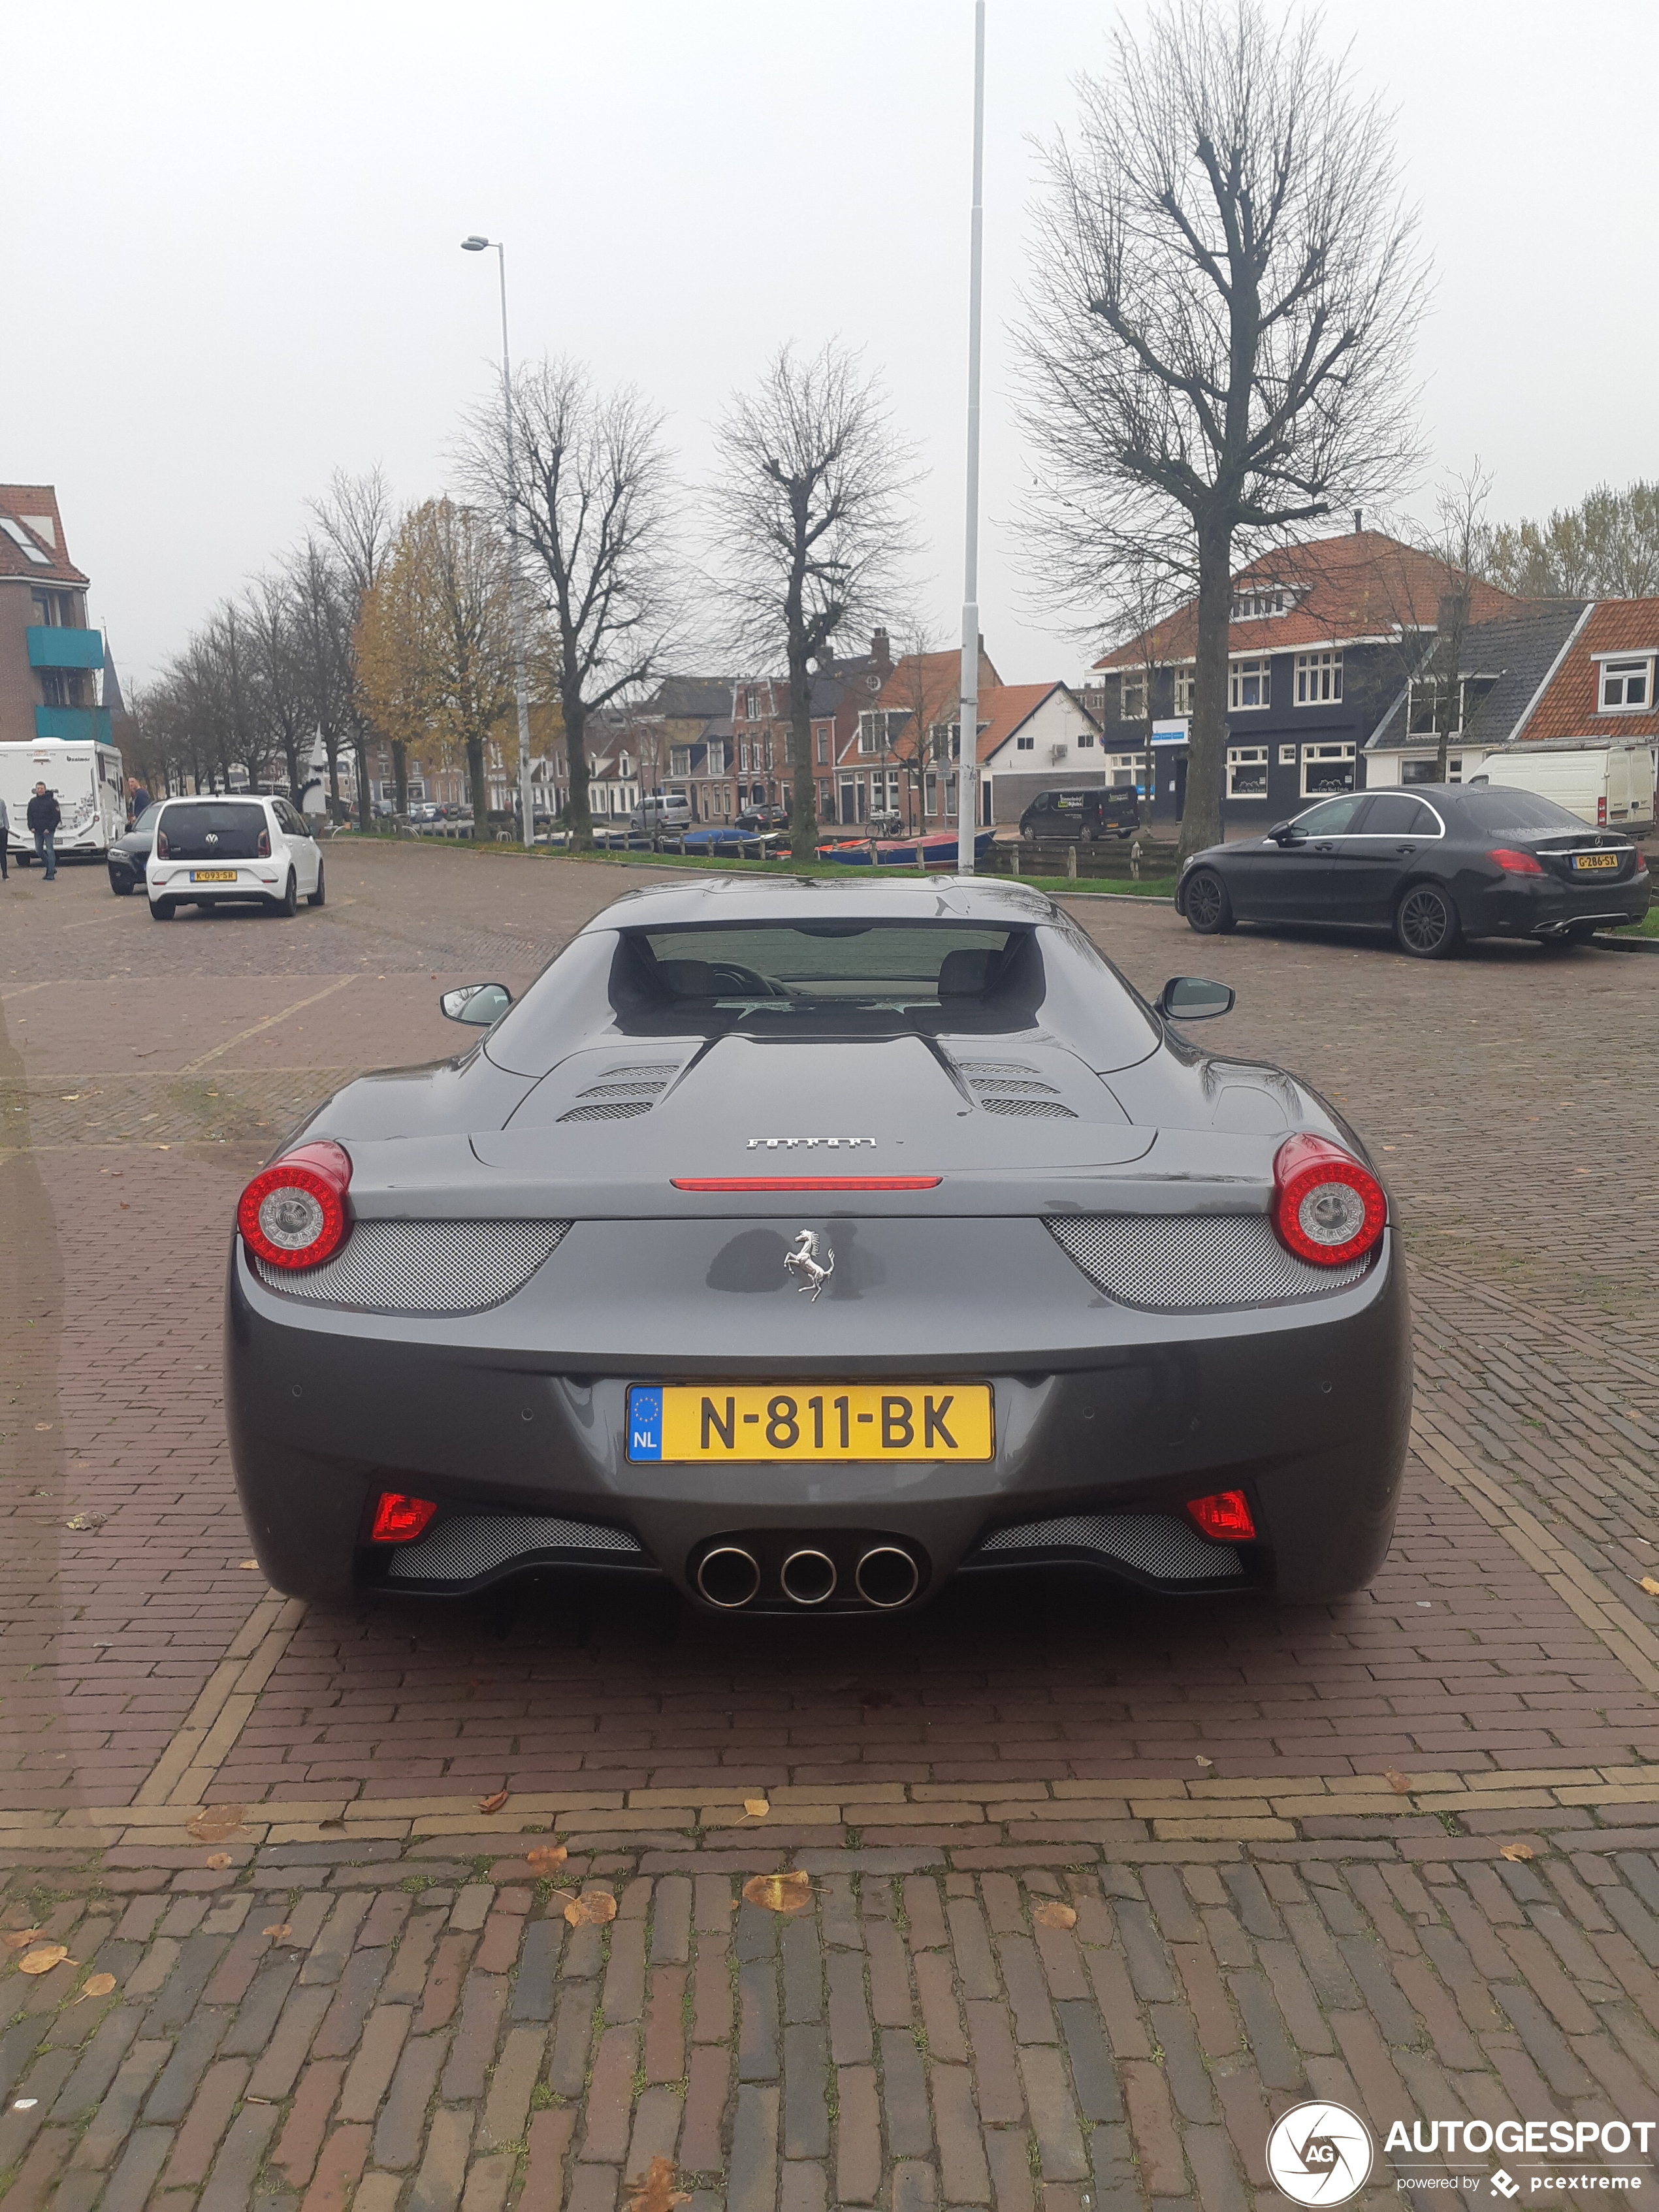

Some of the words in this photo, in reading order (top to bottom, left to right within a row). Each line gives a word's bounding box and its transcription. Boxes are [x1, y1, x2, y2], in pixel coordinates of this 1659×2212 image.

[1579, 855, 1615, 867] G-286-SX
[700, 1396, 959, 1449] N-811-BK
[634, 1432, 657, 1447] NL
